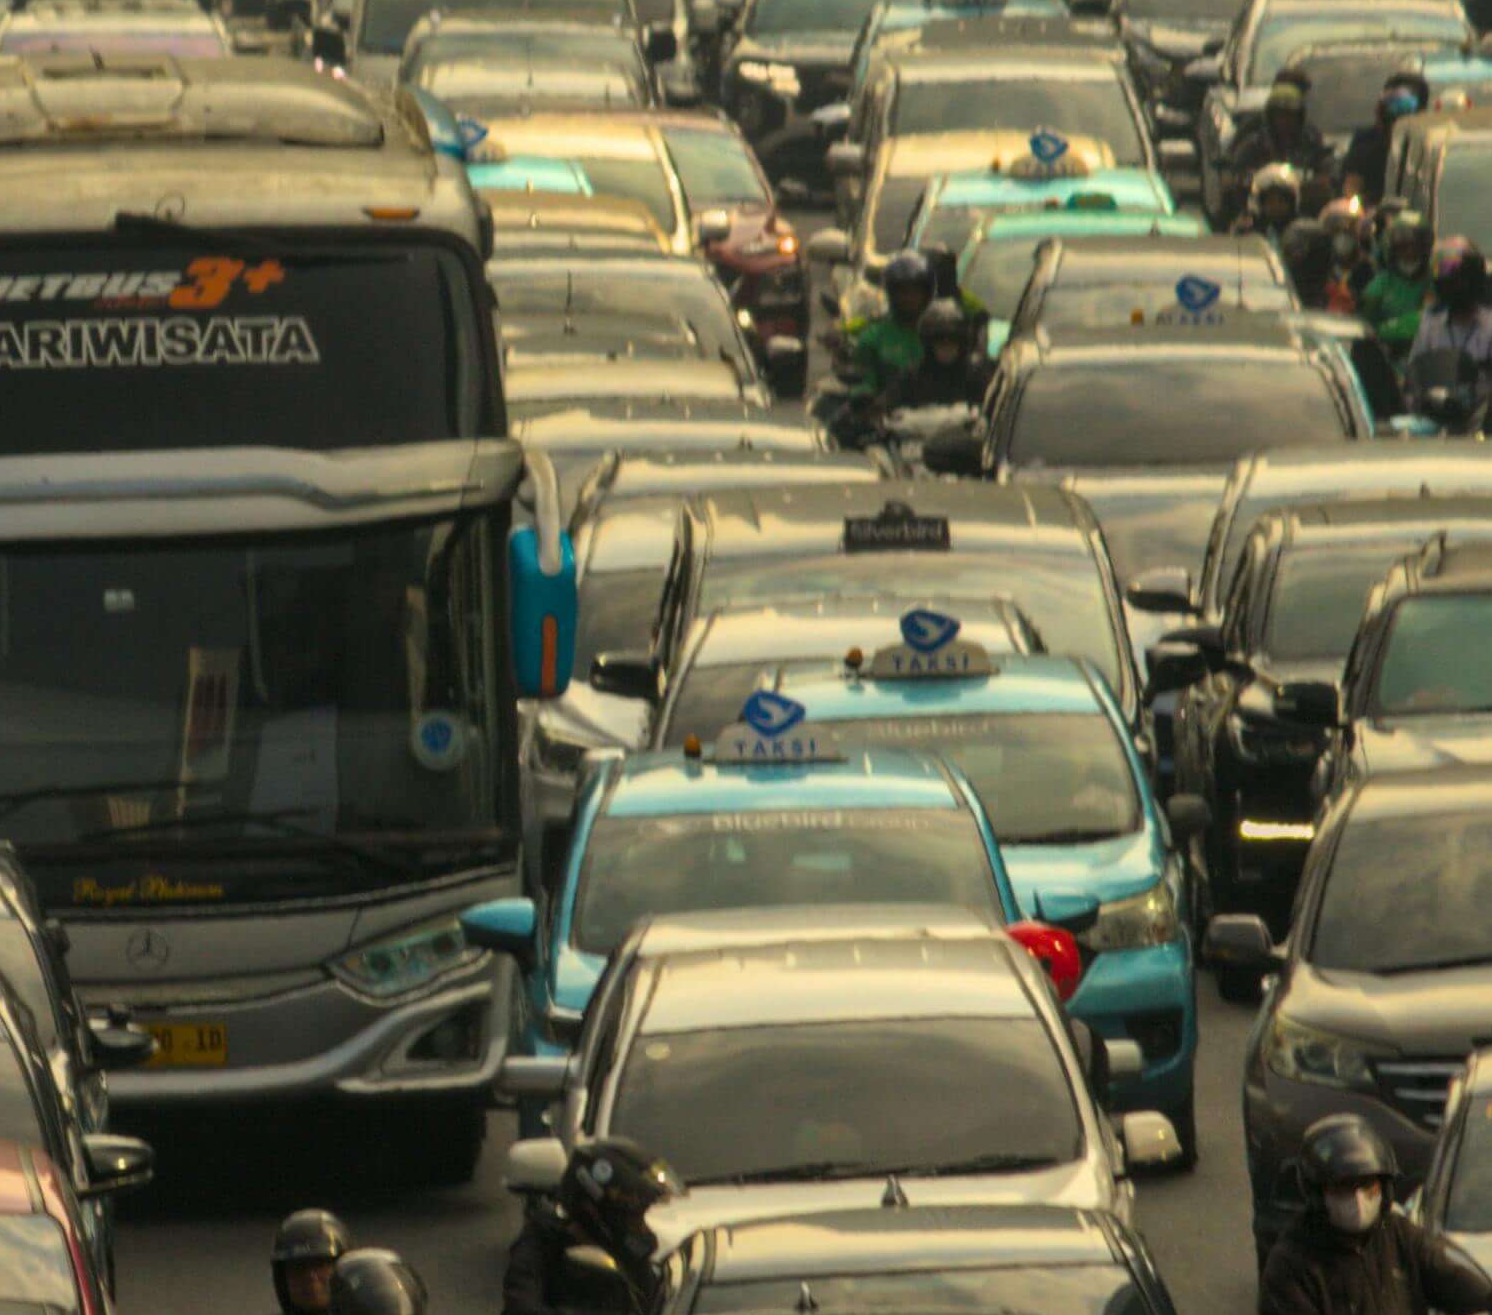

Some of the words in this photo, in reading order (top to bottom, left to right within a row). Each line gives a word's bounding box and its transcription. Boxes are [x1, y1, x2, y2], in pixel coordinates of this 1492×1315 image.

[892, 652, 970, 672] TAKSI
[734, 738, 817, 757] TAKSI
[711, 807, 844, 832] Bluebird
